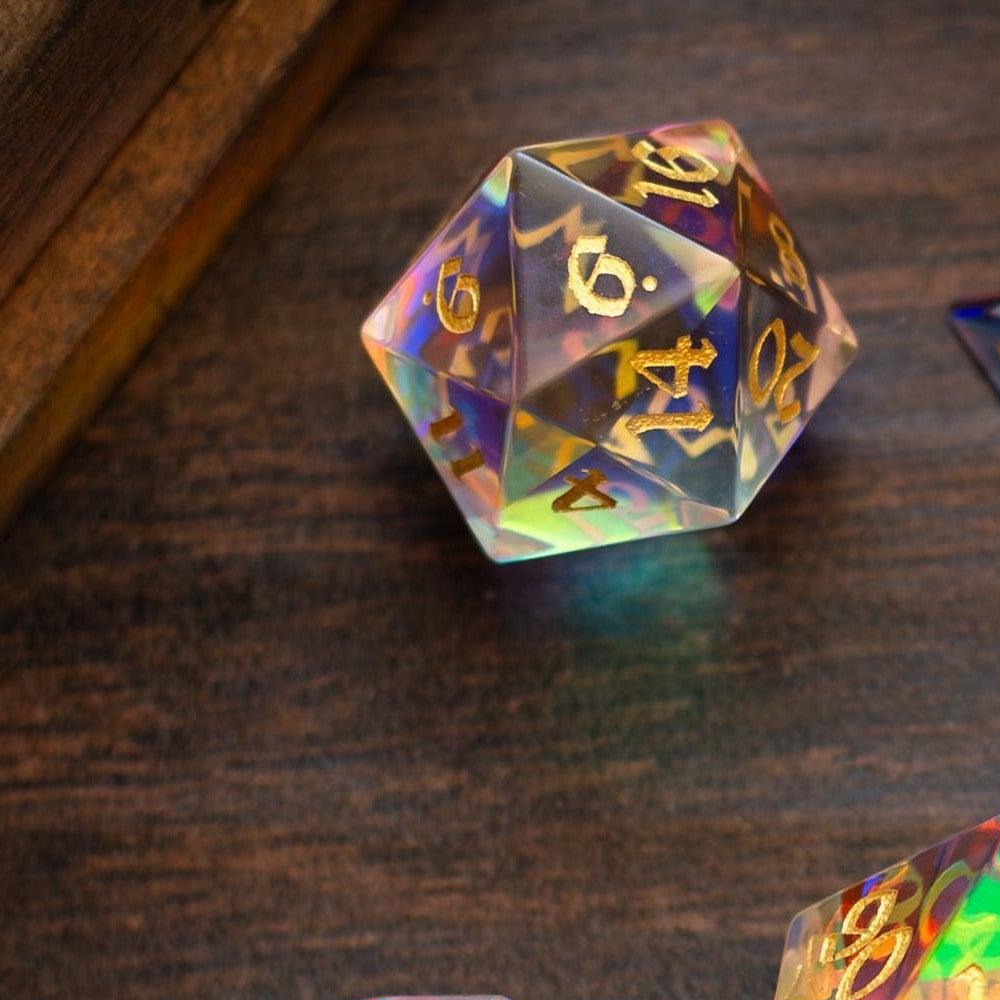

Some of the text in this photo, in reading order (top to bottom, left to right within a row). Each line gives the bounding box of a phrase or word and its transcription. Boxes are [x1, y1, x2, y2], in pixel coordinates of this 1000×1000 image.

[631, 140, 720, 209] 16
[626, 333, 719, 439] 14
[748, 317, 821, 424] 20
